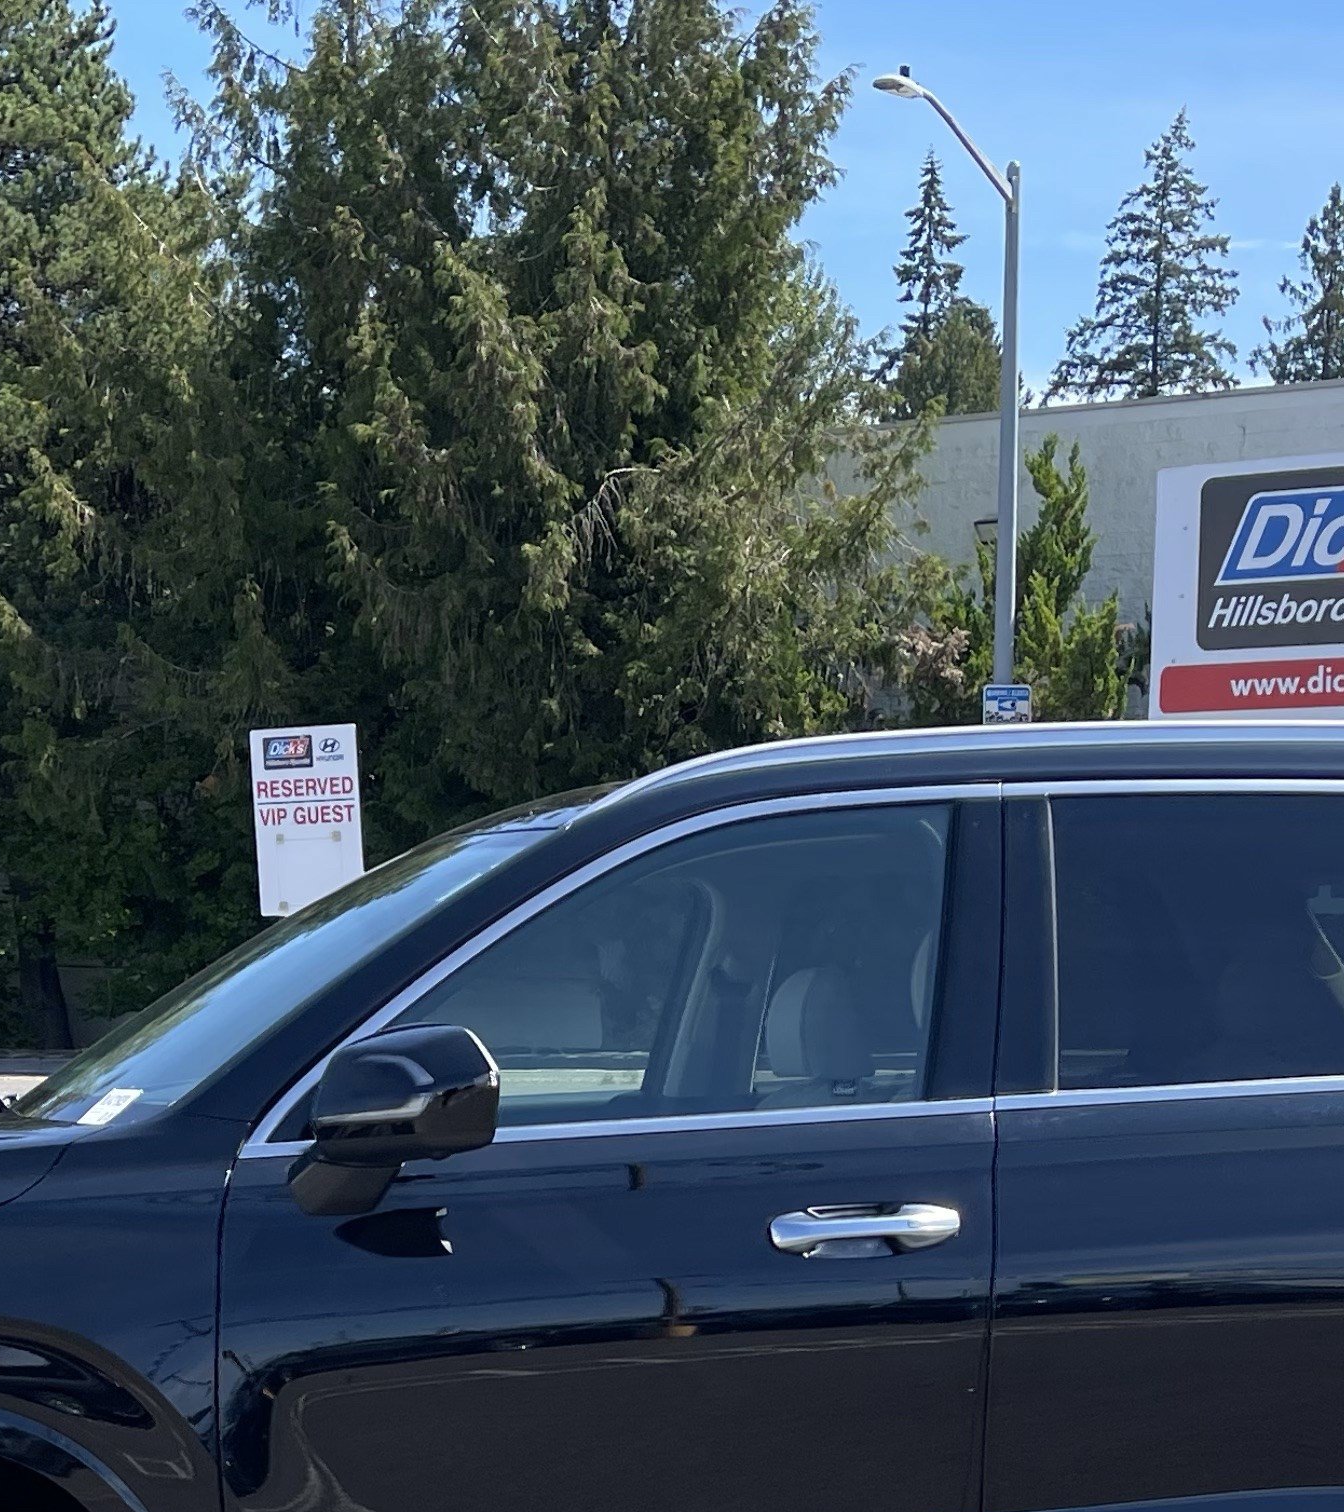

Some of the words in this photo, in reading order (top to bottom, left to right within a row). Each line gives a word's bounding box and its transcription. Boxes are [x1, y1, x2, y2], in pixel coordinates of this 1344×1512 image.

[256, 776, 354, 799] RESERVED
[259, 807, 287, 826] VIP
[293, 804, 355, 825] GUEST
